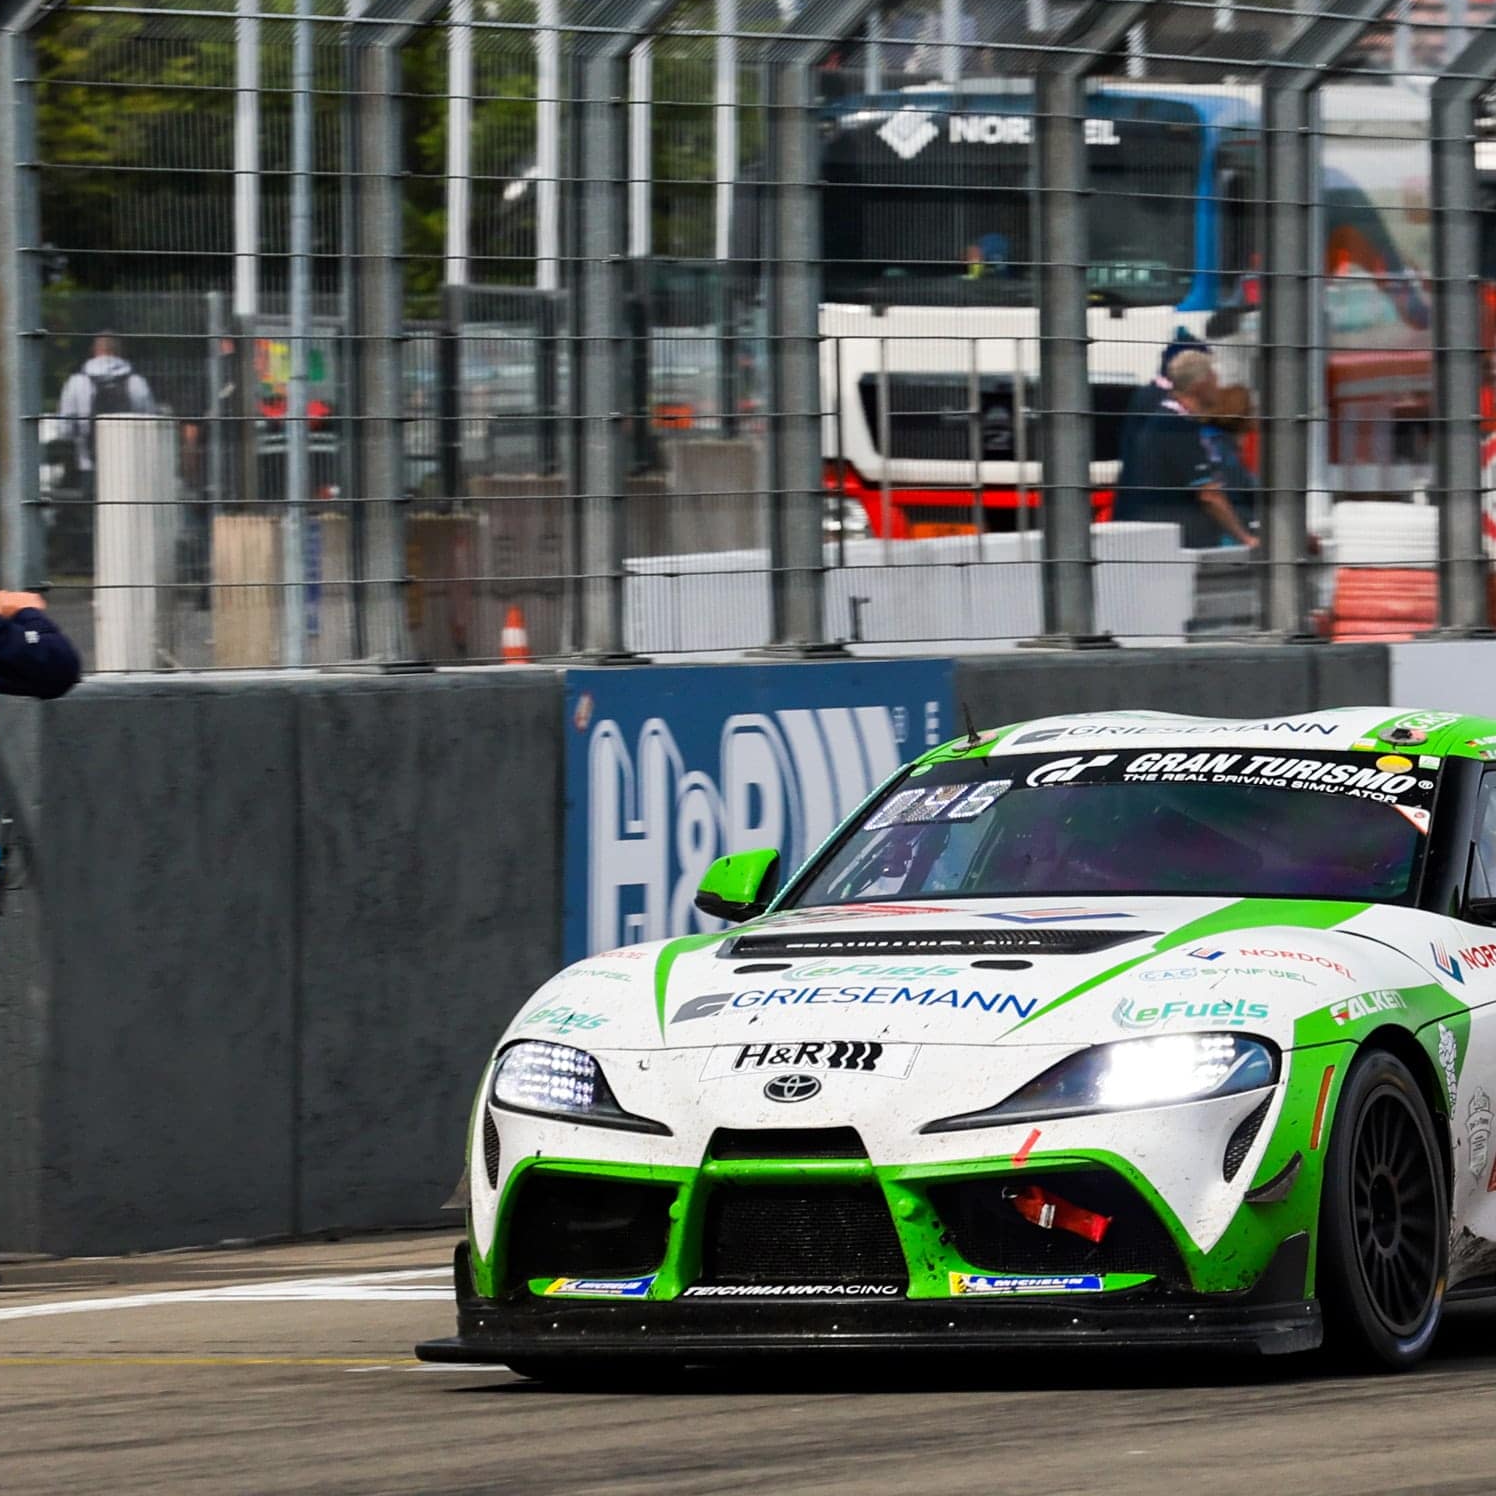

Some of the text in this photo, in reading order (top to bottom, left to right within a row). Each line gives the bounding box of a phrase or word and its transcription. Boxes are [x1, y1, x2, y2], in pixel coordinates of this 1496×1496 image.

[1125, 753, 1242, 775] GRAN
[1122, 773, 1160, 783] THE
[1163, 773, 1208, 783] REAL
[1211, 774, 1288, 789] DRIVING
[813, 964, 968, 979] eFuels
[1238, 948, 1357, 983] NORDOEL
[731, 986, 1039, 1019] GRIESEMANN
[1135, 998, 1270, 1023] eFuels
[1329, 990, 1408, 1027] FALKEN
